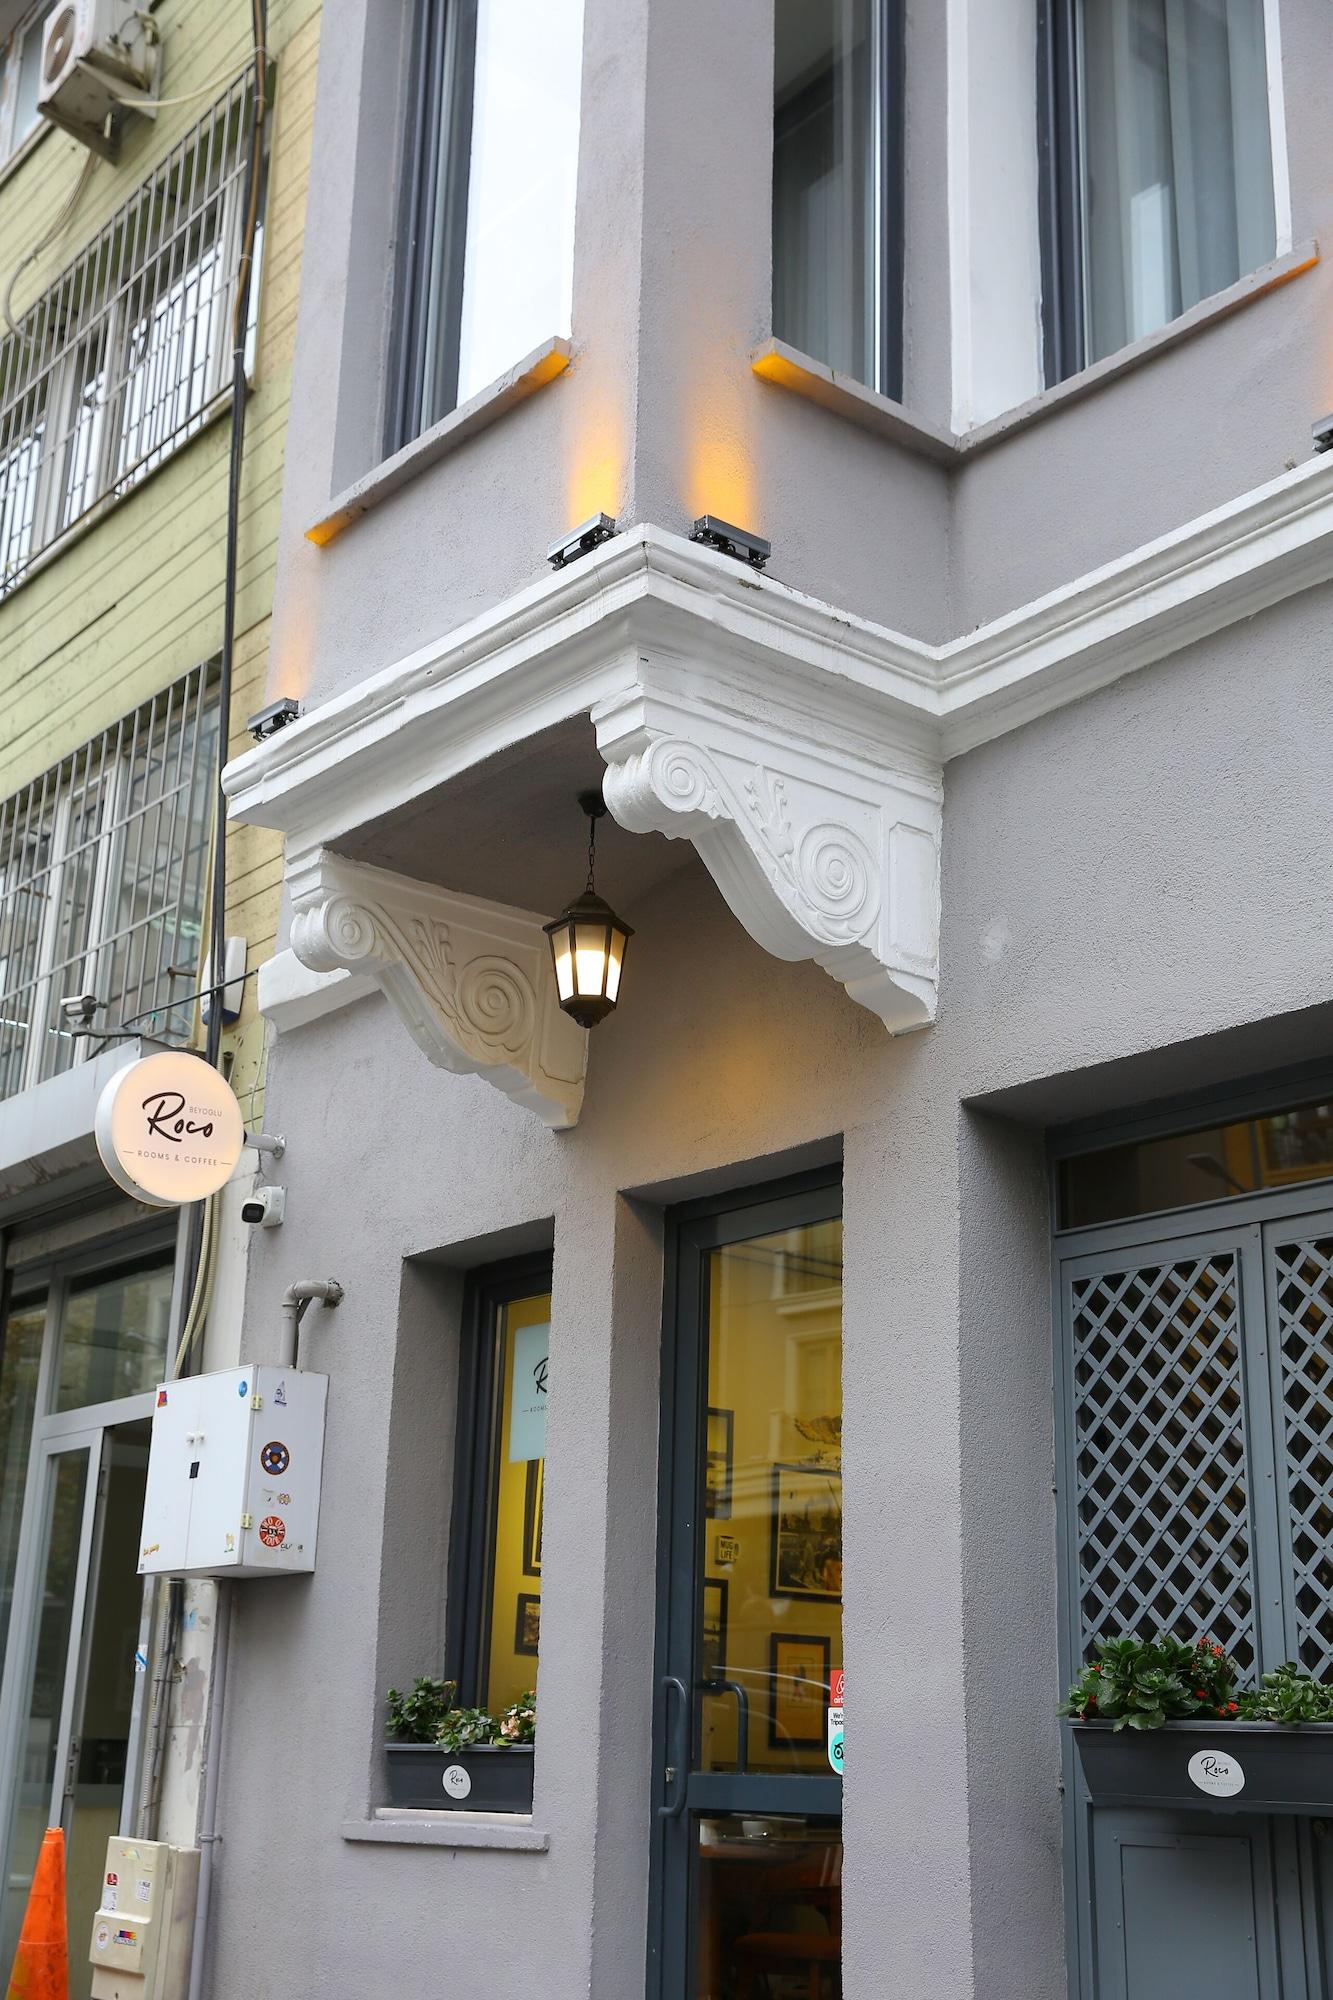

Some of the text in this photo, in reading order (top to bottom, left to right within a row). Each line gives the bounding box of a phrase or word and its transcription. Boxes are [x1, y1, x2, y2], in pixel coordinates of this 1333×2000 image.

[142, 1092, 213, 1142] Roco
[137, 1150, 218, 1166] ROOMS & COFFEE
[1200, 1756, 1229, 1778] Roco
